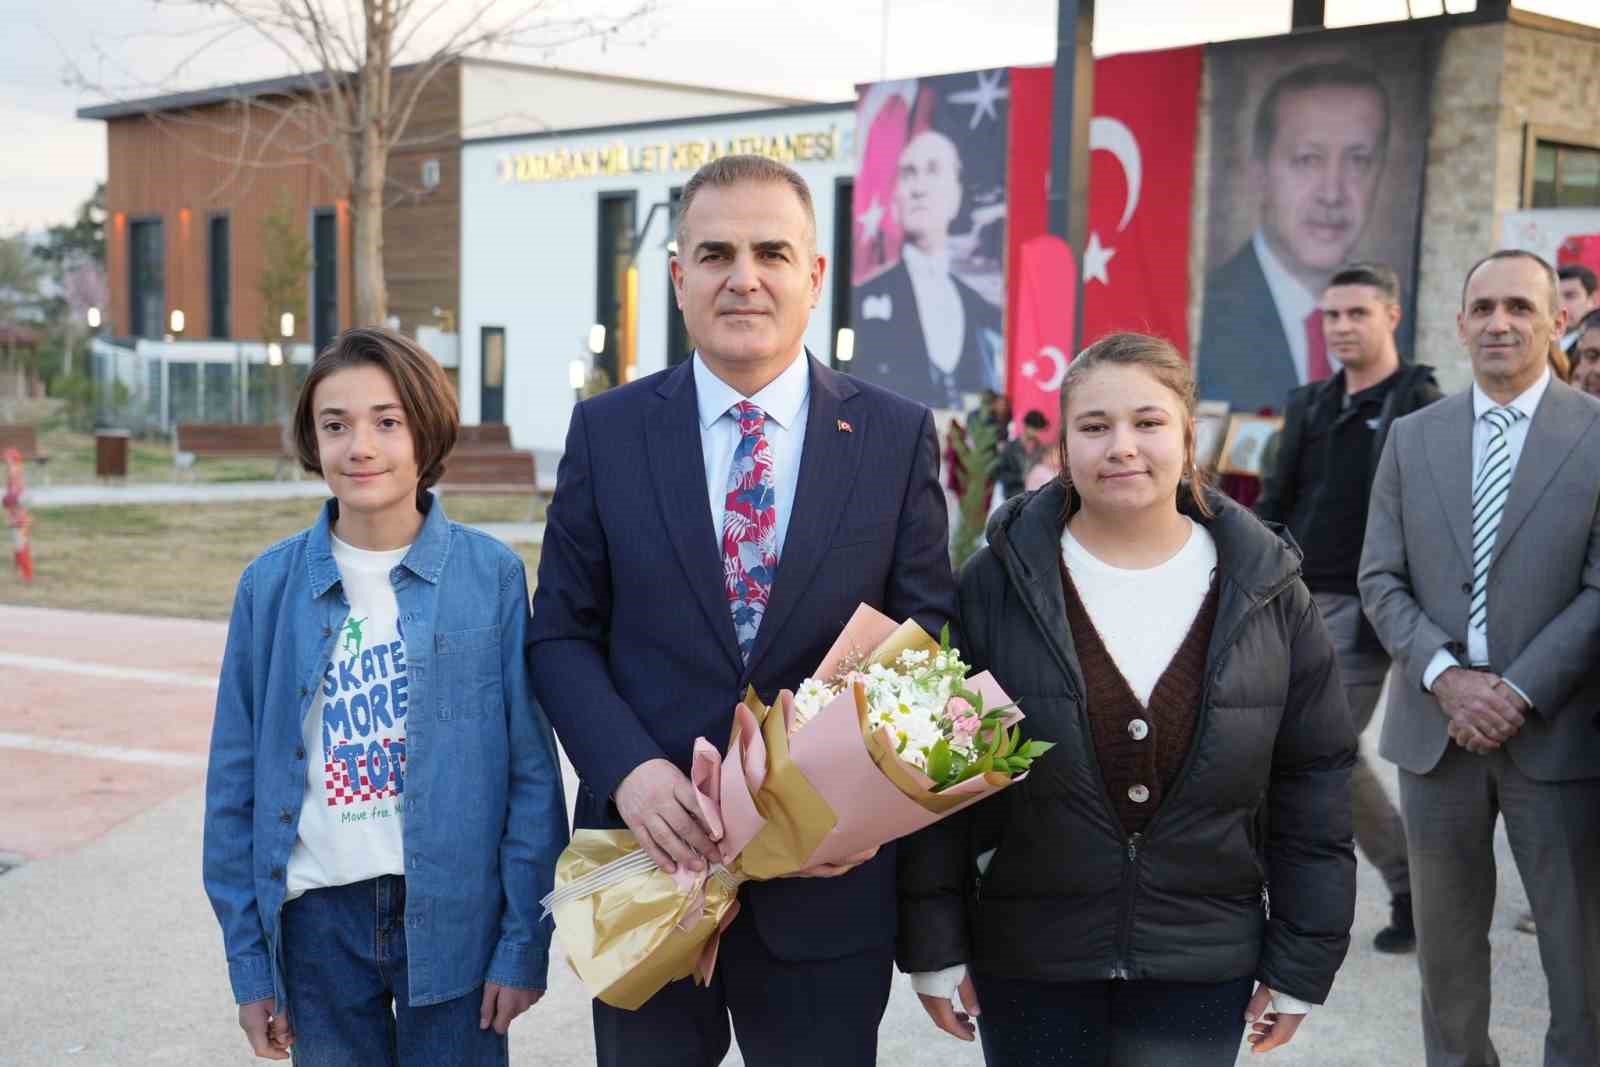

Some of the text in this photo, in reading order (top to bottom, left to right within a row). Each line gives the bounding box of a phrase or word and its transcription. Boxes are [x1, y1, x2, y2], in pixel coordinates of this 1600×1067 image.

[322, 641, 406, 697] SKATE
[322, 675, 408, 762] MORE
[341, 810, 368, 824] Move
